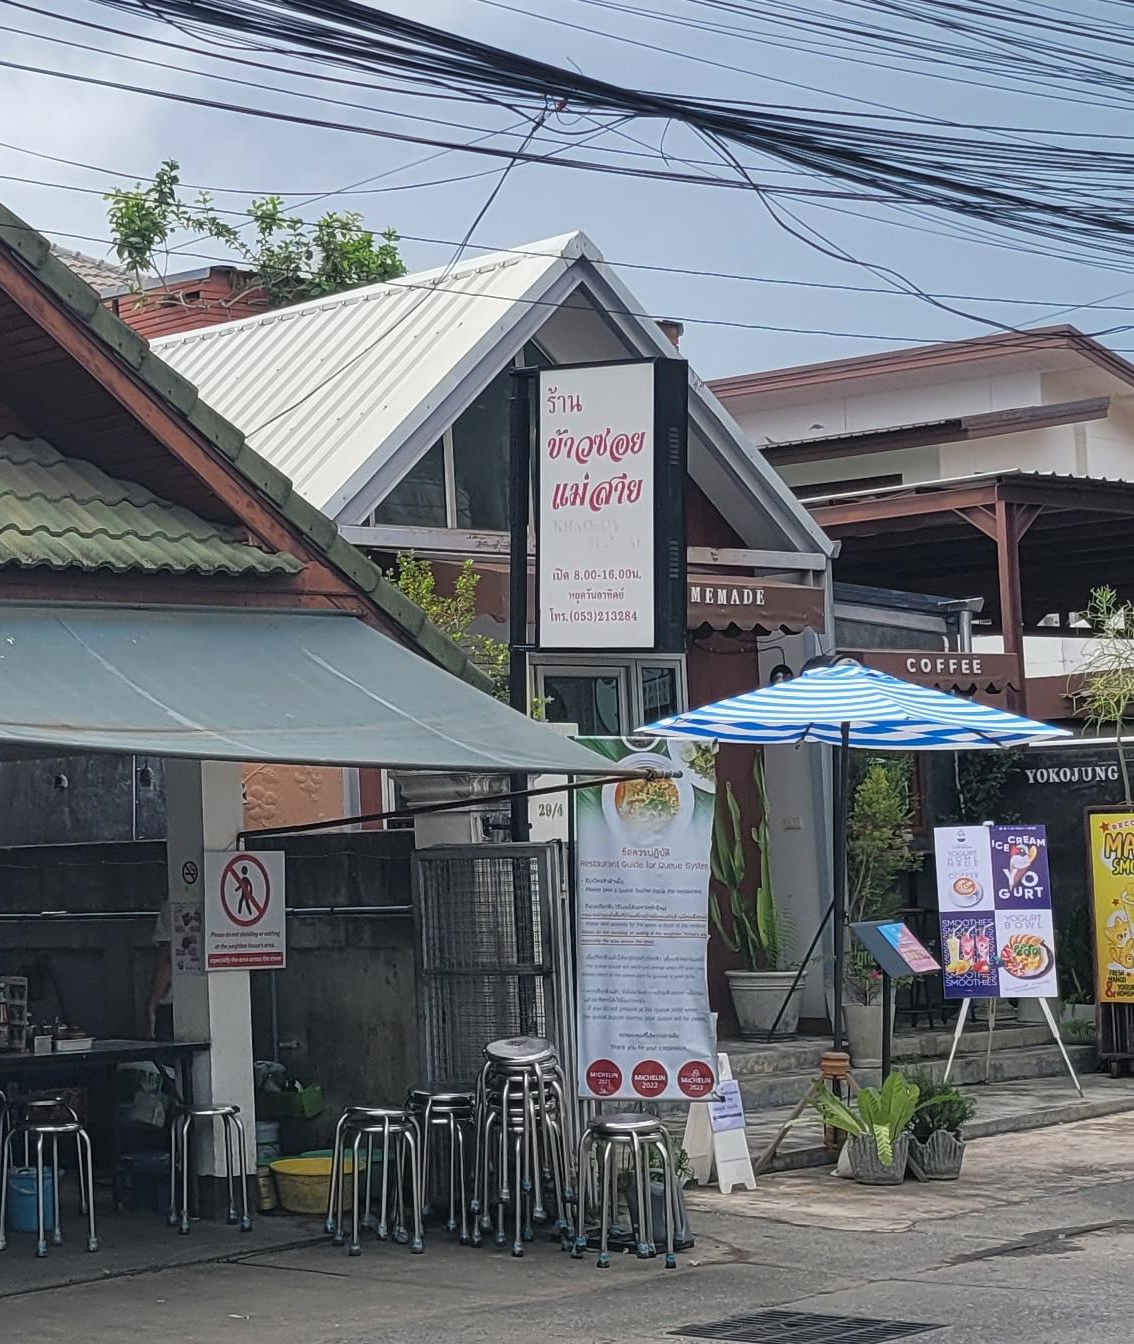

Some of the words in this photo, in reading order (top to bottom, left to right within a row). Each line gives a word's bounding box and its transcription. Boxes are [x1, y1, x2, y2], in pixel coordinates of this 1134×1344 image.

[546, 386, 583, 414] ร้าน
[547, 427, 646, 465] ข้าวซอย
[552, 472, 643, 512] แม่สาย
[906, 658, 982, 674] COFFEE
[1025, 765, 1119, 784] YOKOJUNG
[991, 839, 1010, 853] ICE
[1007, 835, 1046, 847] CREAM
[946, 979, 997, 987] SMOOTHIES
[590, 1071, 619, 1079] MICHELIN
[634, 1074, 666, 1082] MICHELIN
[681, 1077, 712, 1085] MICHELIN
[641, 1081, 659, 1089] 2022
